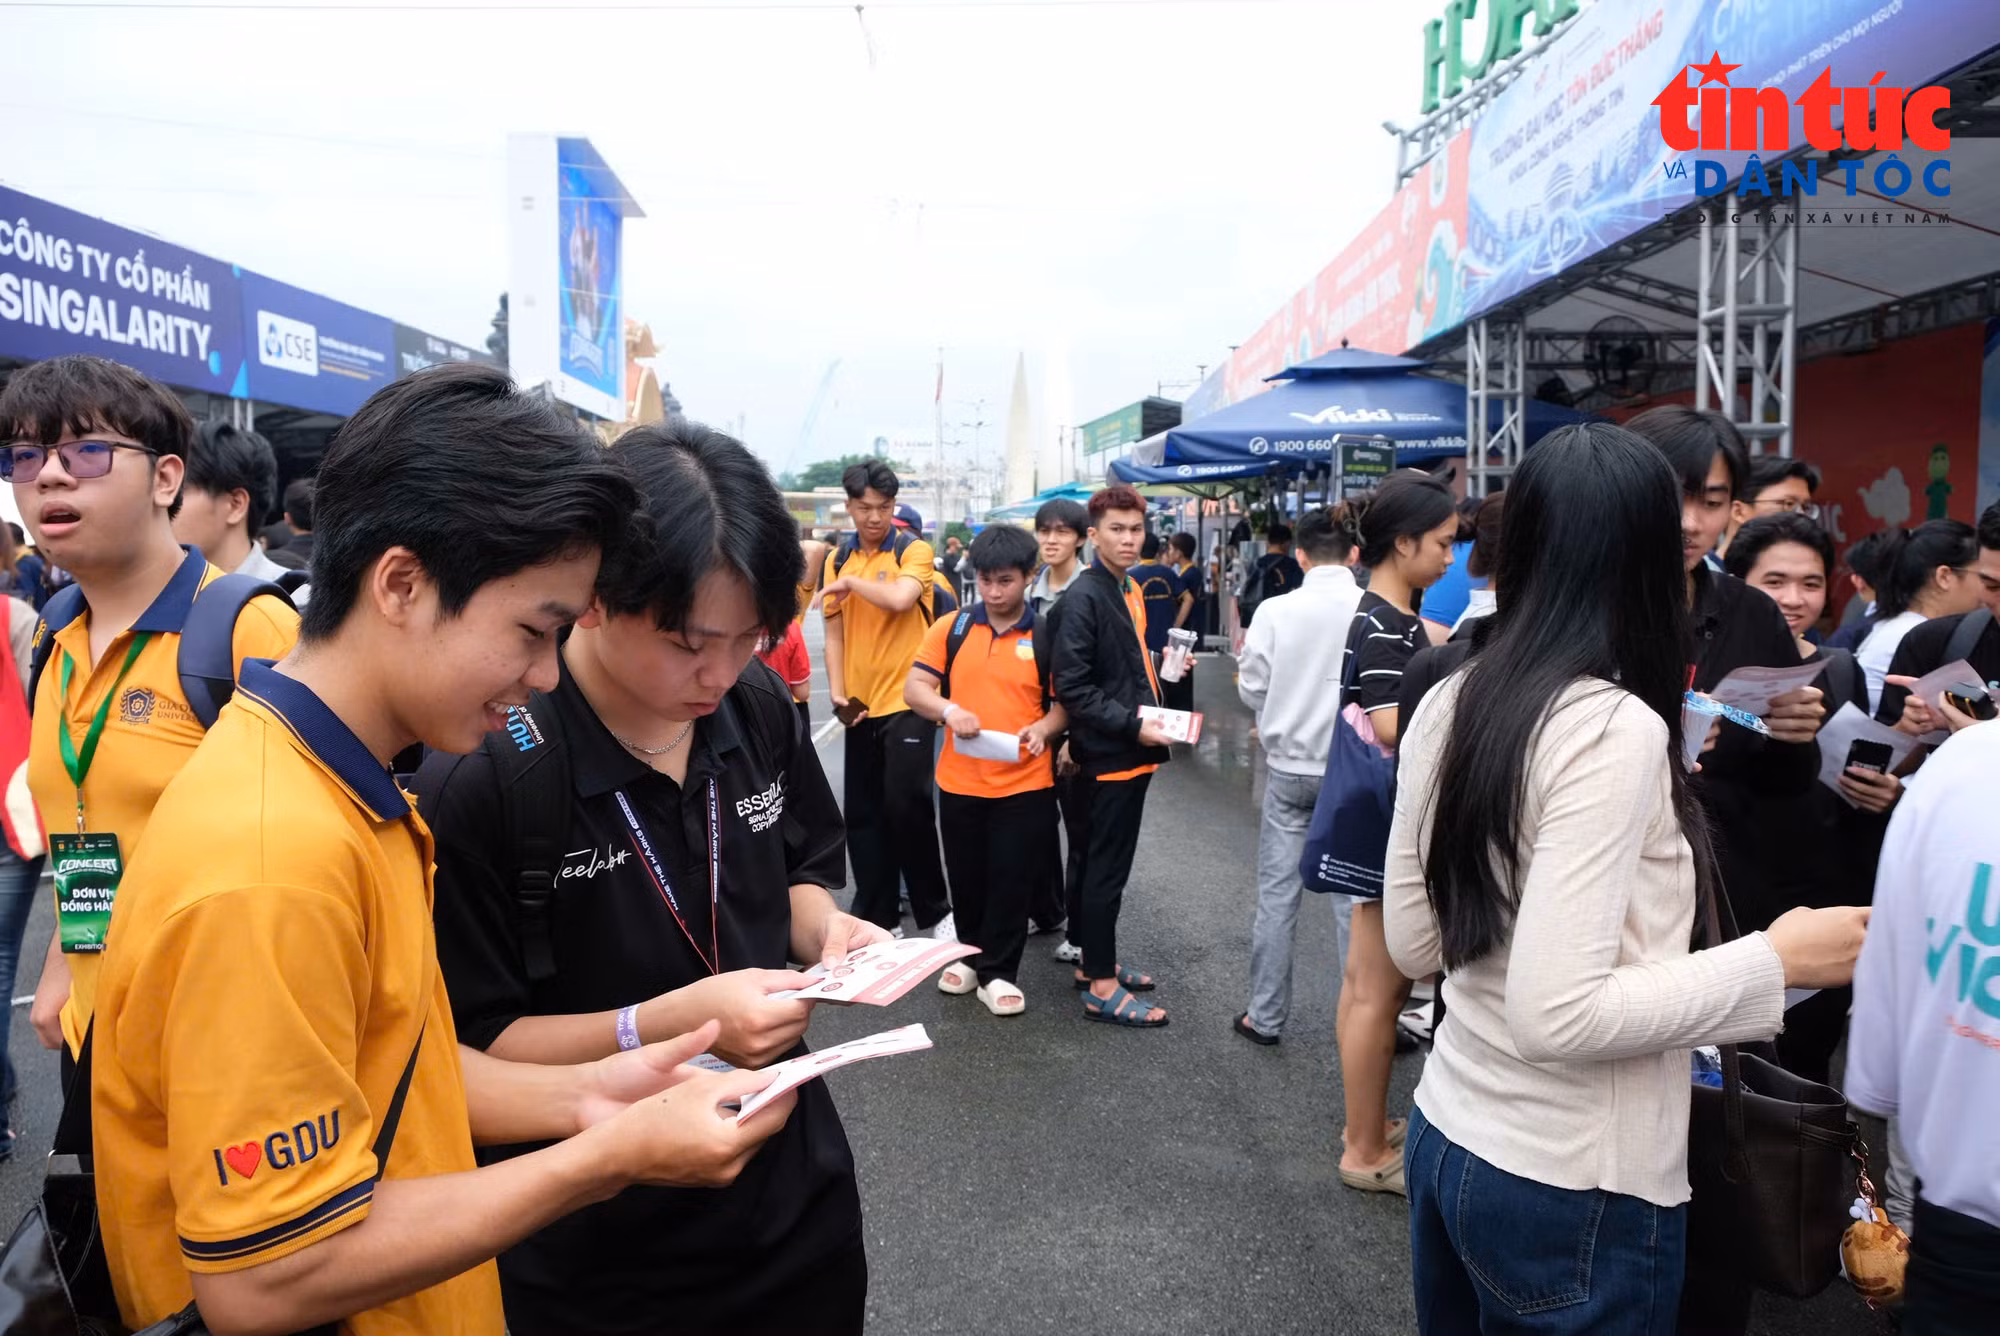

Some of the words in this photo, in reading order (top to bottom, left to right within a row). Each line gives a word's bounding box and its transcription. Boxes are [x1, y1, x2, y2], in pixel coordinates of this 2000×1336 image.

[0, 217, 74, 272] CÔNG
[76, 244, 111, 282] TY
[115, 249, 149, 293] CỔ
[152, 264, 211, 311] PHẦN
[0, 272, 211, 361] SINGALARITY
[284, 332, 313, 362] CSE
[1274, 440, 1303, 452] 1900
[1306, 438, 1334, 451] 660
[158, 700, 177, 711] GIA
[635, 829, 658, 864] MARKS
[58, 858, 118, 873] CONCERT
[654, 864, 667, 885] THE
[72, 887, 97, 899] ĐƠN
[664, 885, 679, 911] MAKE
[213, 1149, 228, 1186] I
[264, 1109, 340, 1170] GDU
